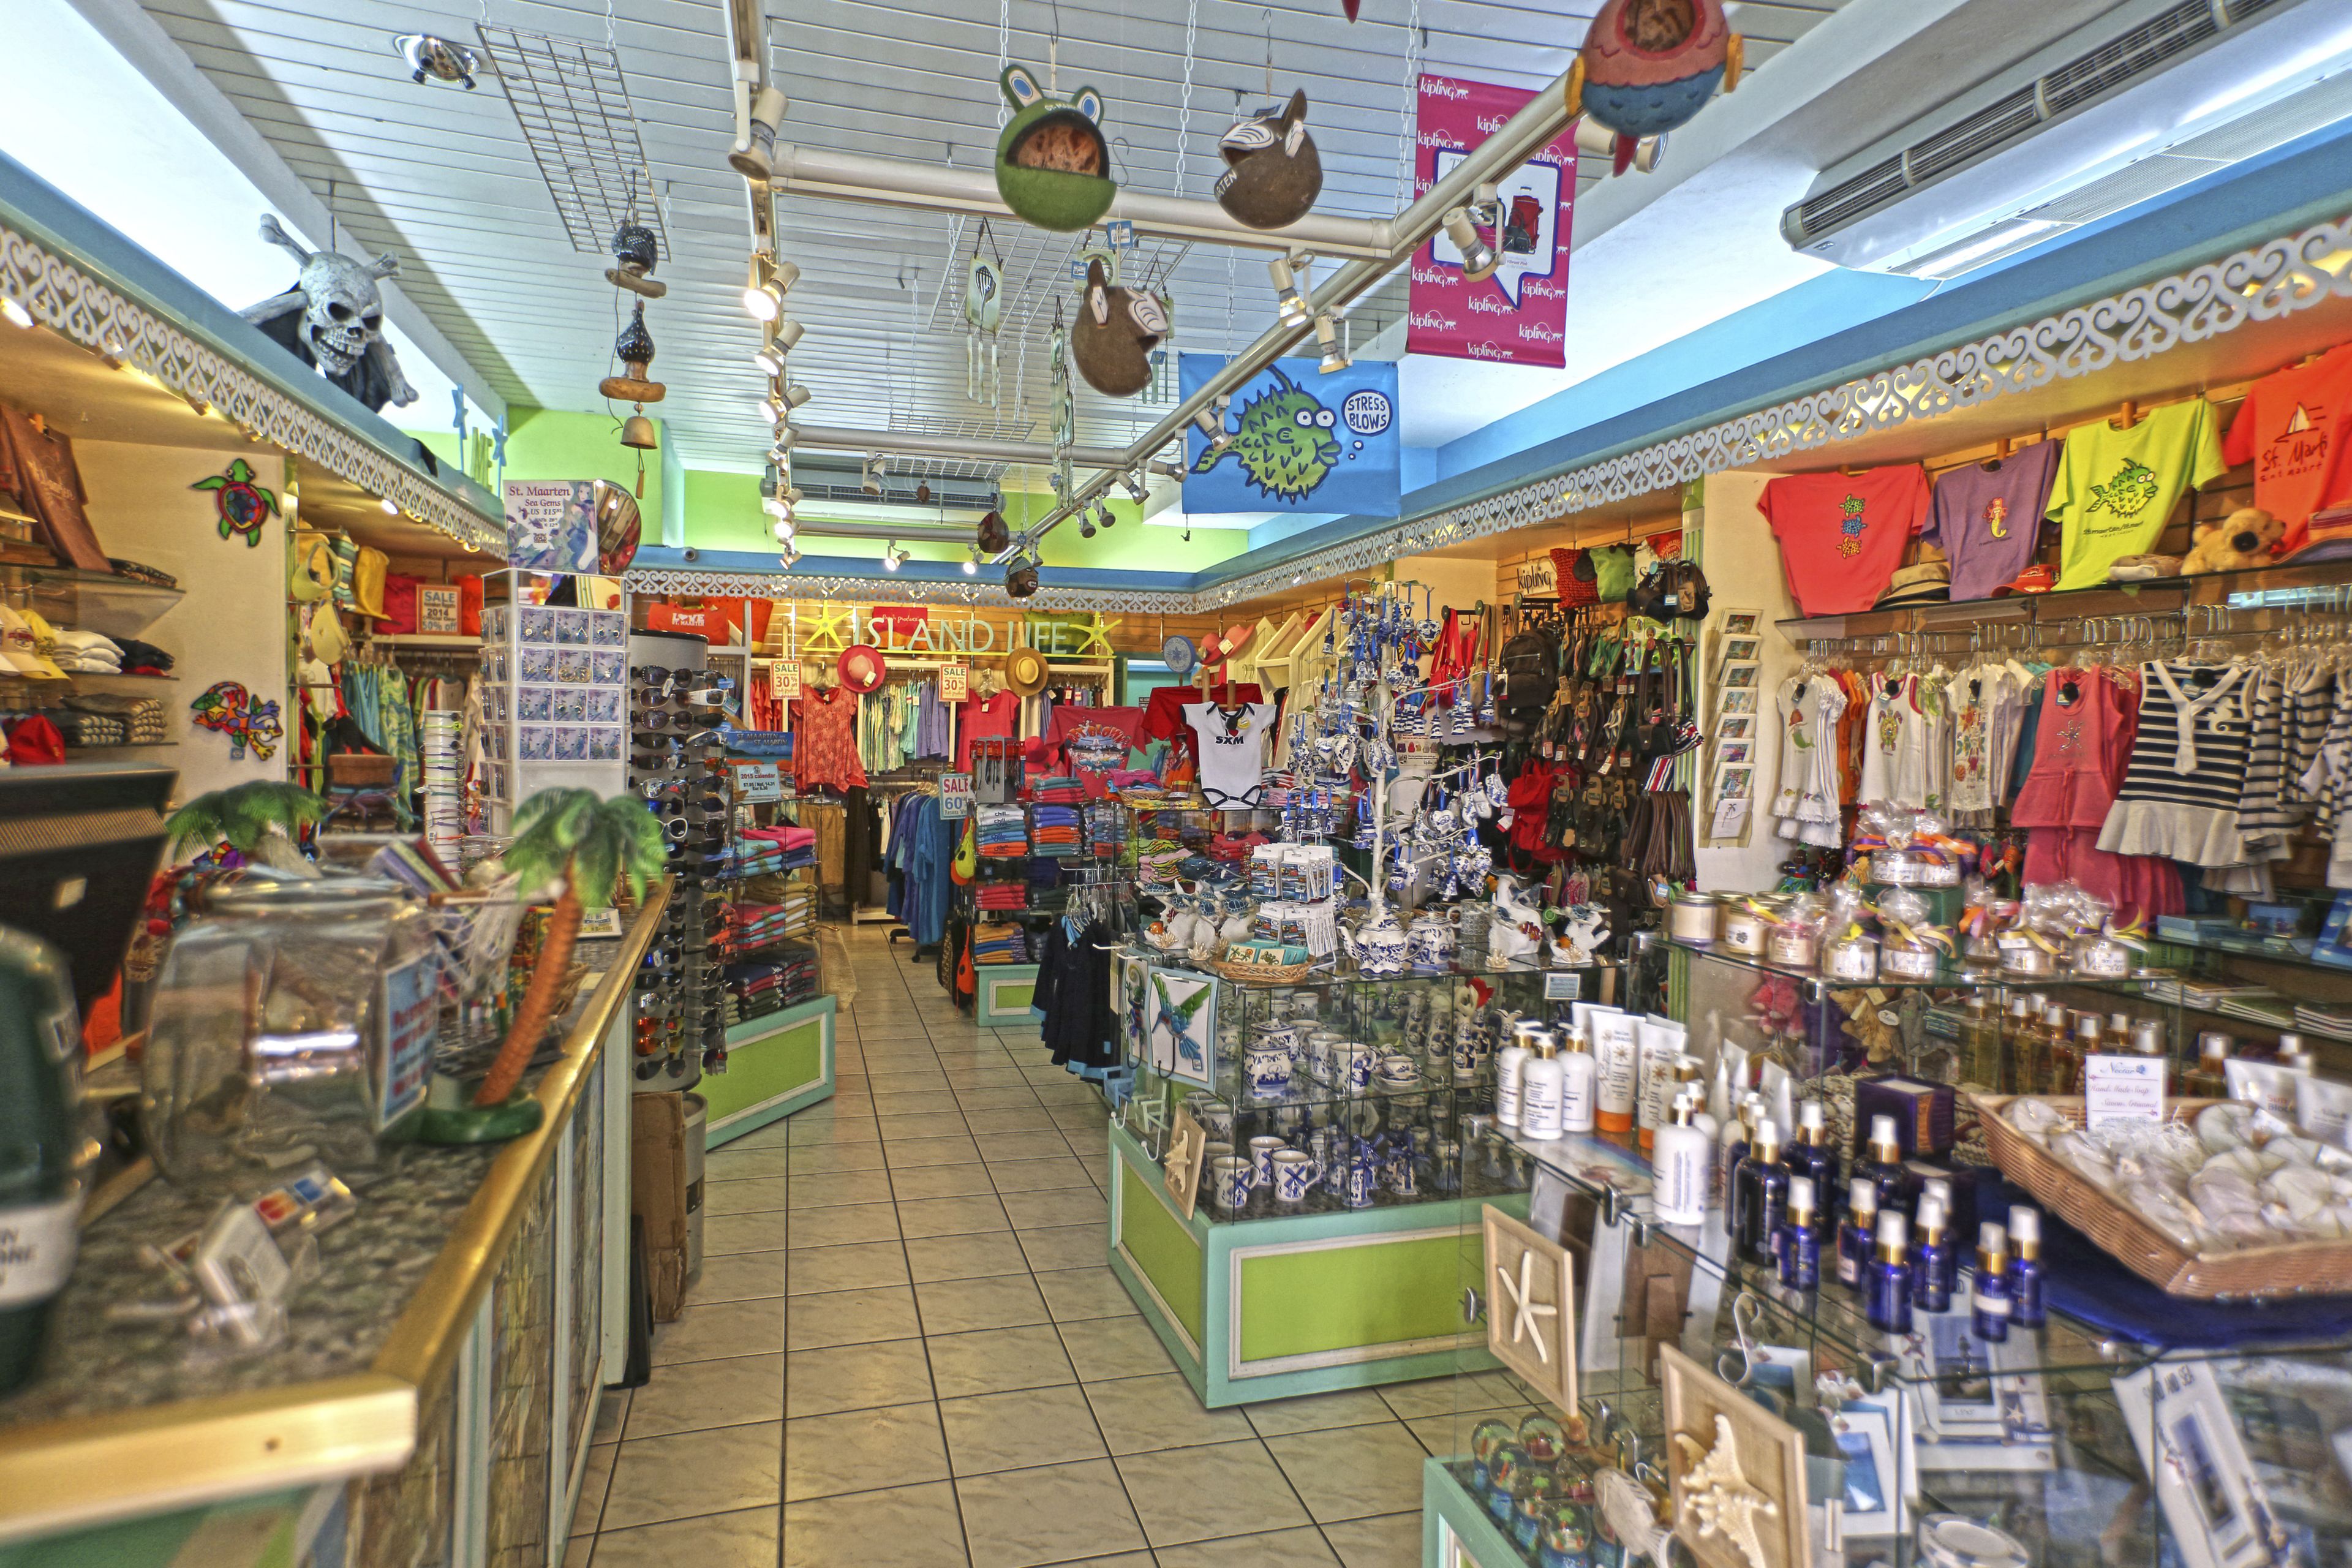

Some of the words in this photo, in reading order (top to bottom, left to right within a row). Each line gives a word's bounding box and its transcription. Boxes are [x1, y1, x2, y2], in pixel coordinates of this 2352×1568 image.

[1420, 77, 1454, 100] kipling
[1412, 266, 1445, 287] kipling
[1521, 281, 1553, 300] kipling
[1468, 296, 1501, 316] kipling
[1410, 312, 1442, 331] kipling
[1519, 324, 1550, 343] kipling
[1467, 342, 1500, 360] kipling
[1348, 396, 1385, 412] STRESS
[1349, 412, 1387, 430] BLOWS
[509, 486, 523, 496] St.
[527, 486, 570, 496] Maarten
[1517, 565, 1551, 593] kipling
[425, 591, 455, 603] SALE
[853, 617, 994, 652] ISLAND
[1008, 621, 1068, 654] LIFE
[1215, 736, 1244, 745] SXM
[944, 778, 968, 793] SALE
[945, 797, 962, 810] 60
[2100, 1062, 2135, 1074] Nectar
